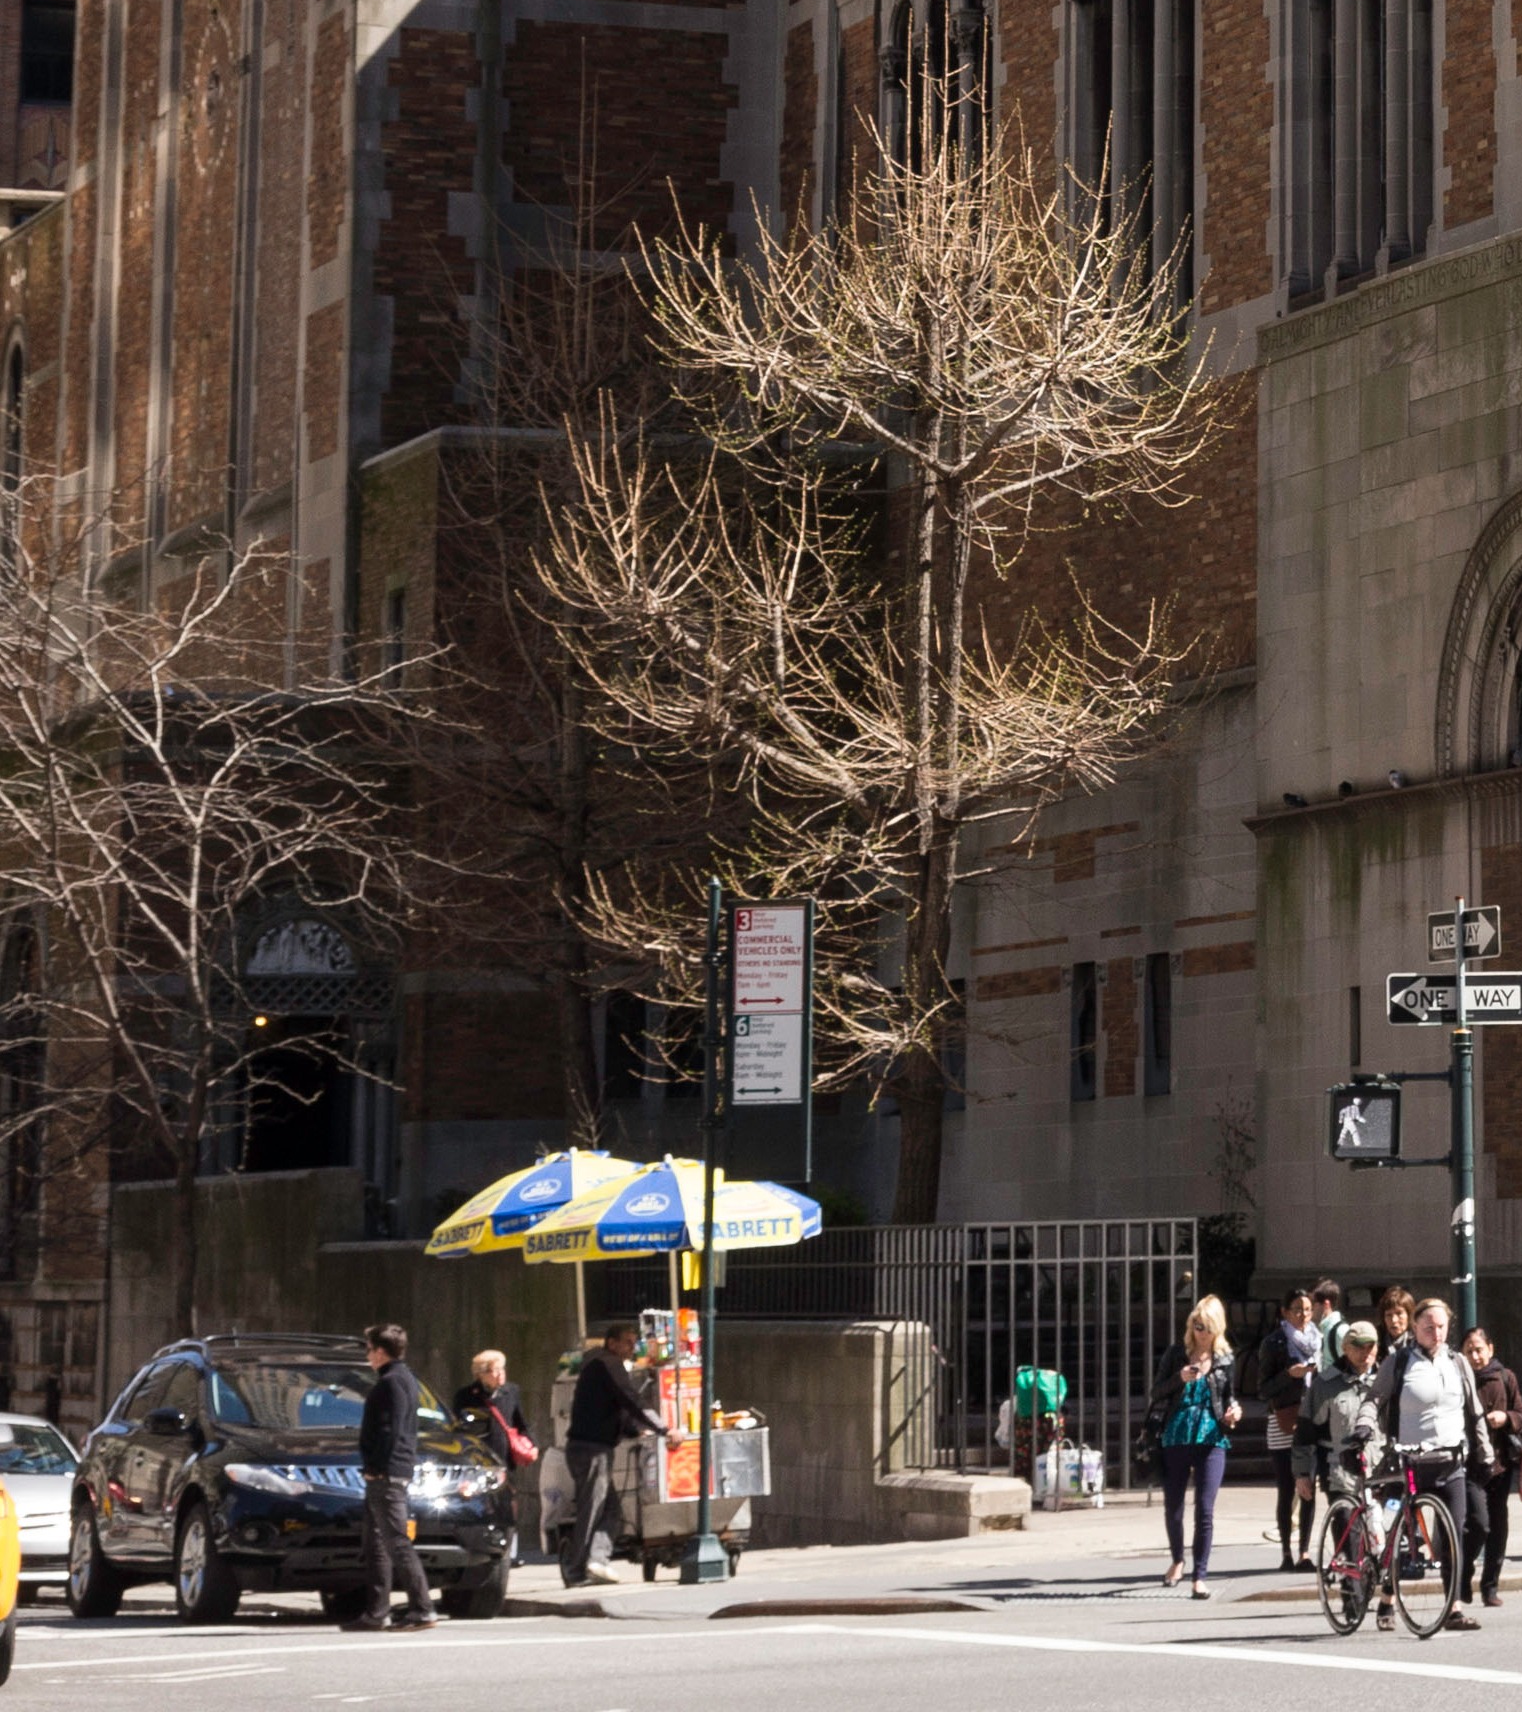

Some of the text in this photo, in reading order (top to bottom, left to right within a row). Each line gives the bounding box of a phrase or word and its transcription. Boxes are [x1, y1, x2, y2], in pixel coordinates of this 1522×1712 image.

[738, 911, 750, 930] 3
[738, 935, 793, 944] COMMERCIAL
[1435, 925, 1455, 946] ONE
[738, 946, 802, 955] VEHICLES ONLY
[1404, 989, 1515, 1009] ONE WAY
[736, 1016, 748, 1035] 6
[430, 1221, 485, 1248] SABRETT
[526, 1229, 592, 1254] SABRETT
